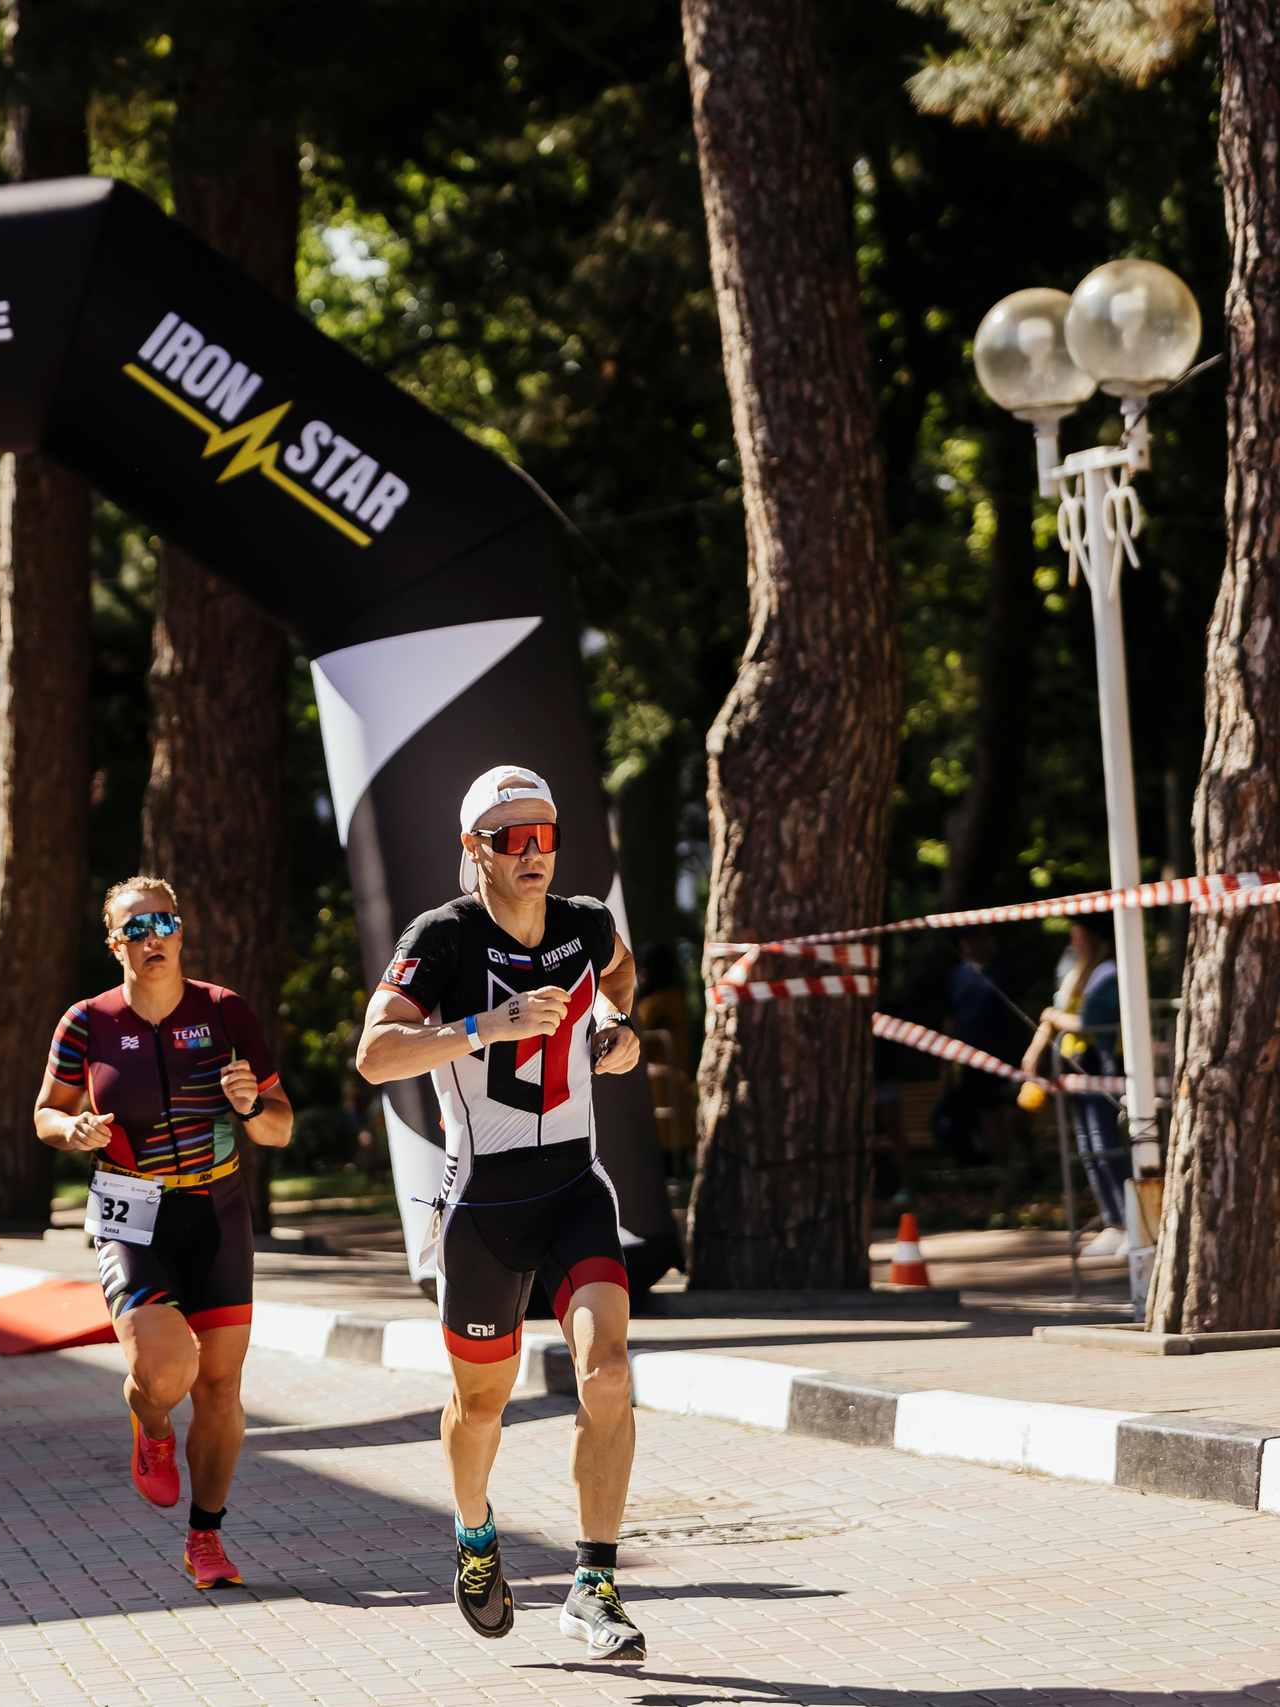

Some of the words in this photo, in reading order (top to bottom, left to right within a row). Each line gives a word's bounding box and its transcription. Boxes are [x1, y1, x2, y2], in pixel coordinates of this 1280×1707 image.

[136, 310, 264, 423] IRON
[283, 419, 411, 533] STAR
[541, 937, 583, 967] LYATSKIY
[544, 962, 561, 973] TEAM
[508, 1000, 521, 1024] 183
[172, 1025, 211, 1040] ТЕМП
[101, 1197, 130, 1224] 32
